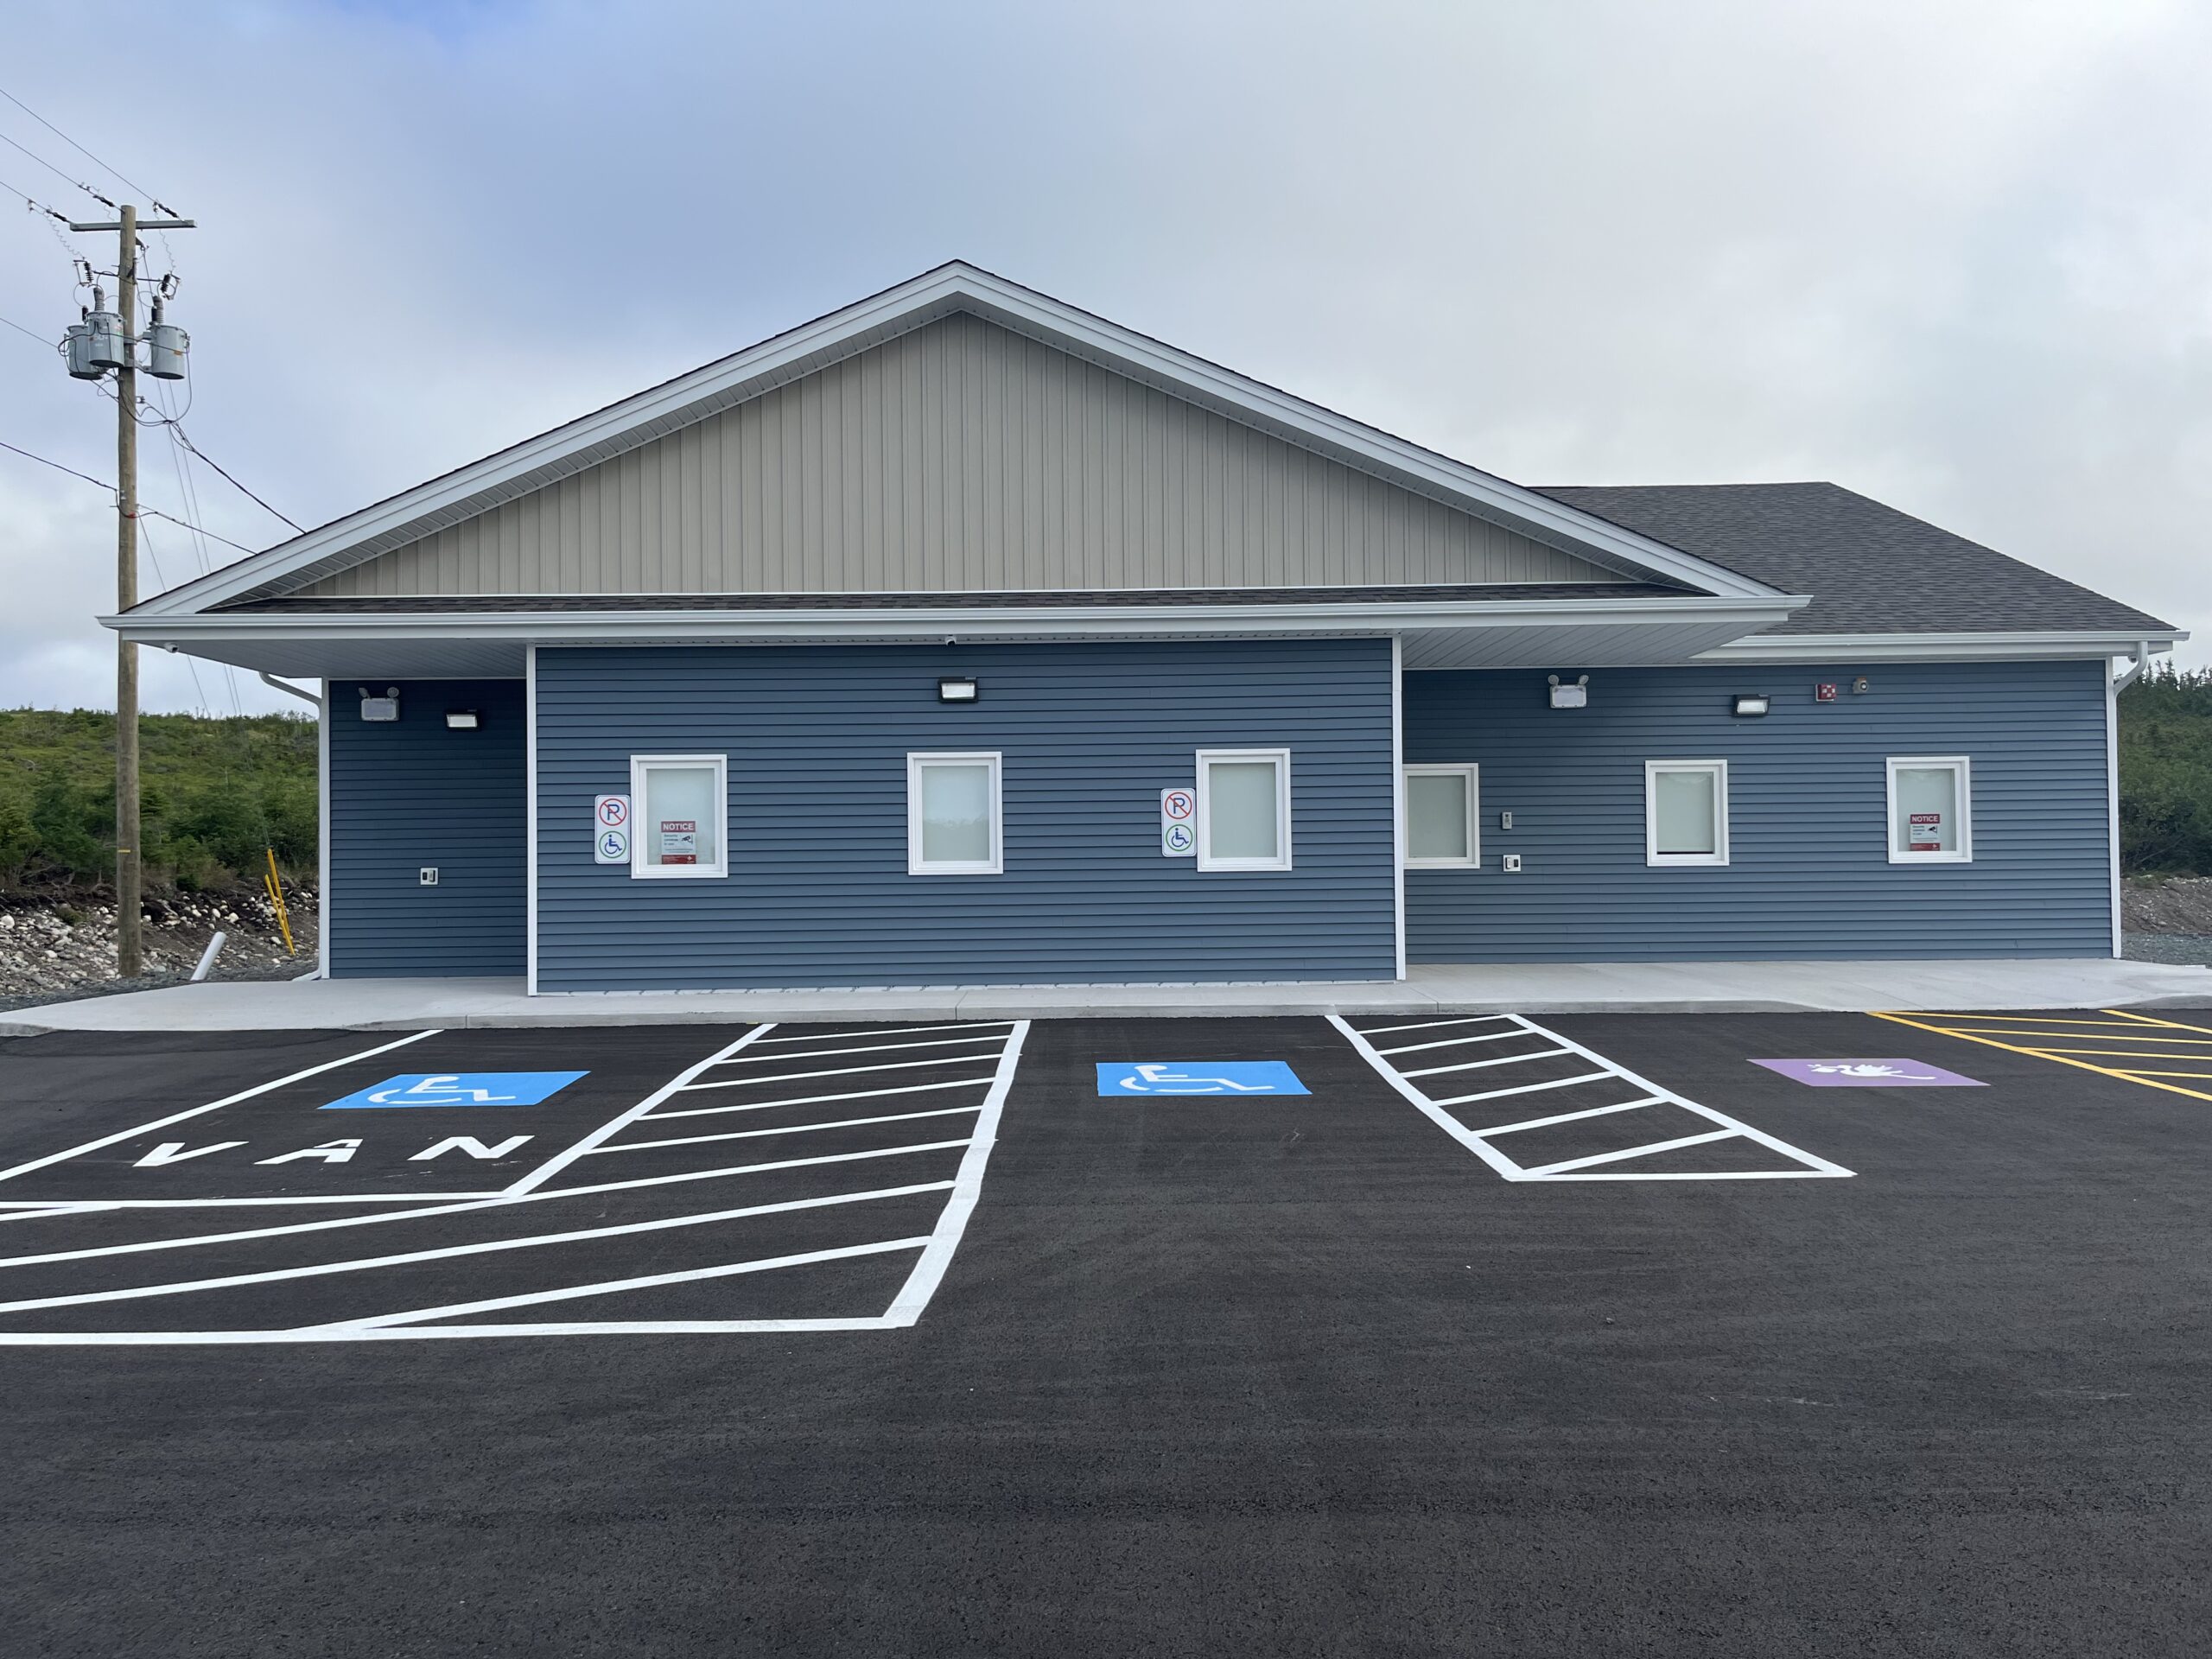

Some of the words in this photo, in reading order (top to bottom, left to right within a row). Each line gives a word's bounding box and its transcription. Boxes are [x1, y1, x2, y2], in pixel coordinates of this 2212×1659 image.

[607, 804, 620, 820] P
[1173, 798, 1185, 814] P
[132, 1135, 536, 1167] VAN
